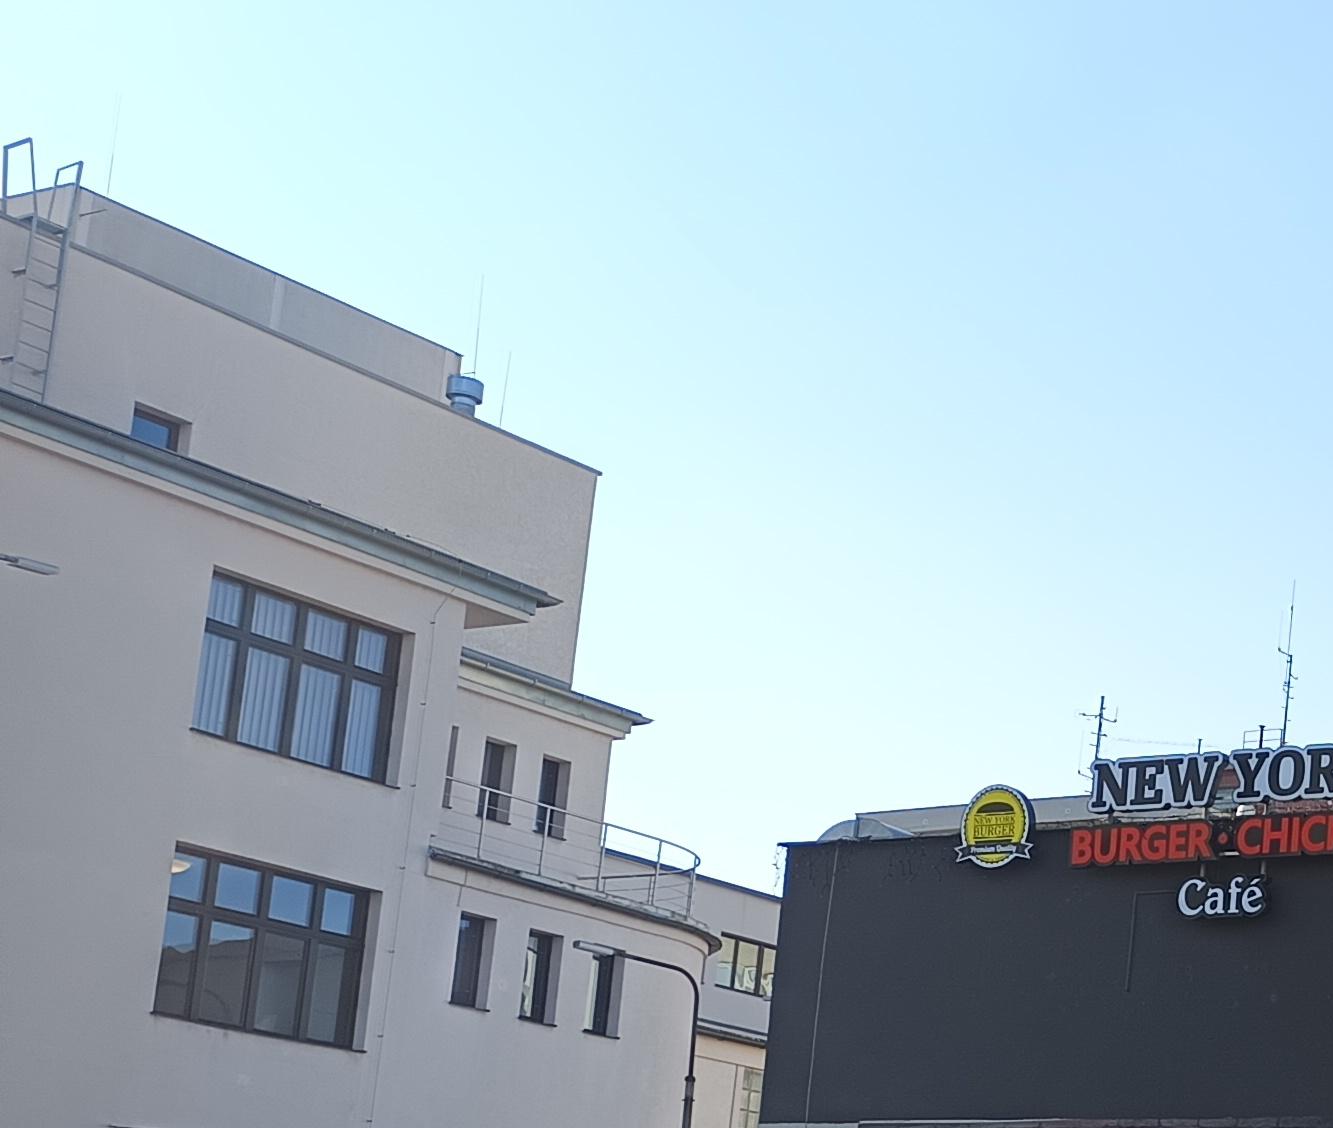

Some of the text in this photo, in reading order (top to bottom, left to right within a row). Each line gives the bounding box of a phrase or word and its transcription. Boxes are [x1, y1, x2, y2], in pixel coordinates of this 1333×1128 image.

[1089, 754, 1220, 811] NEW
[974, 815, 1015, 825] NEW YORK
[974, 824, 1015, 837] BURGER
[1071, 822, 1212, 866] BURGER
[1178, 876, 1263, 916] Café
